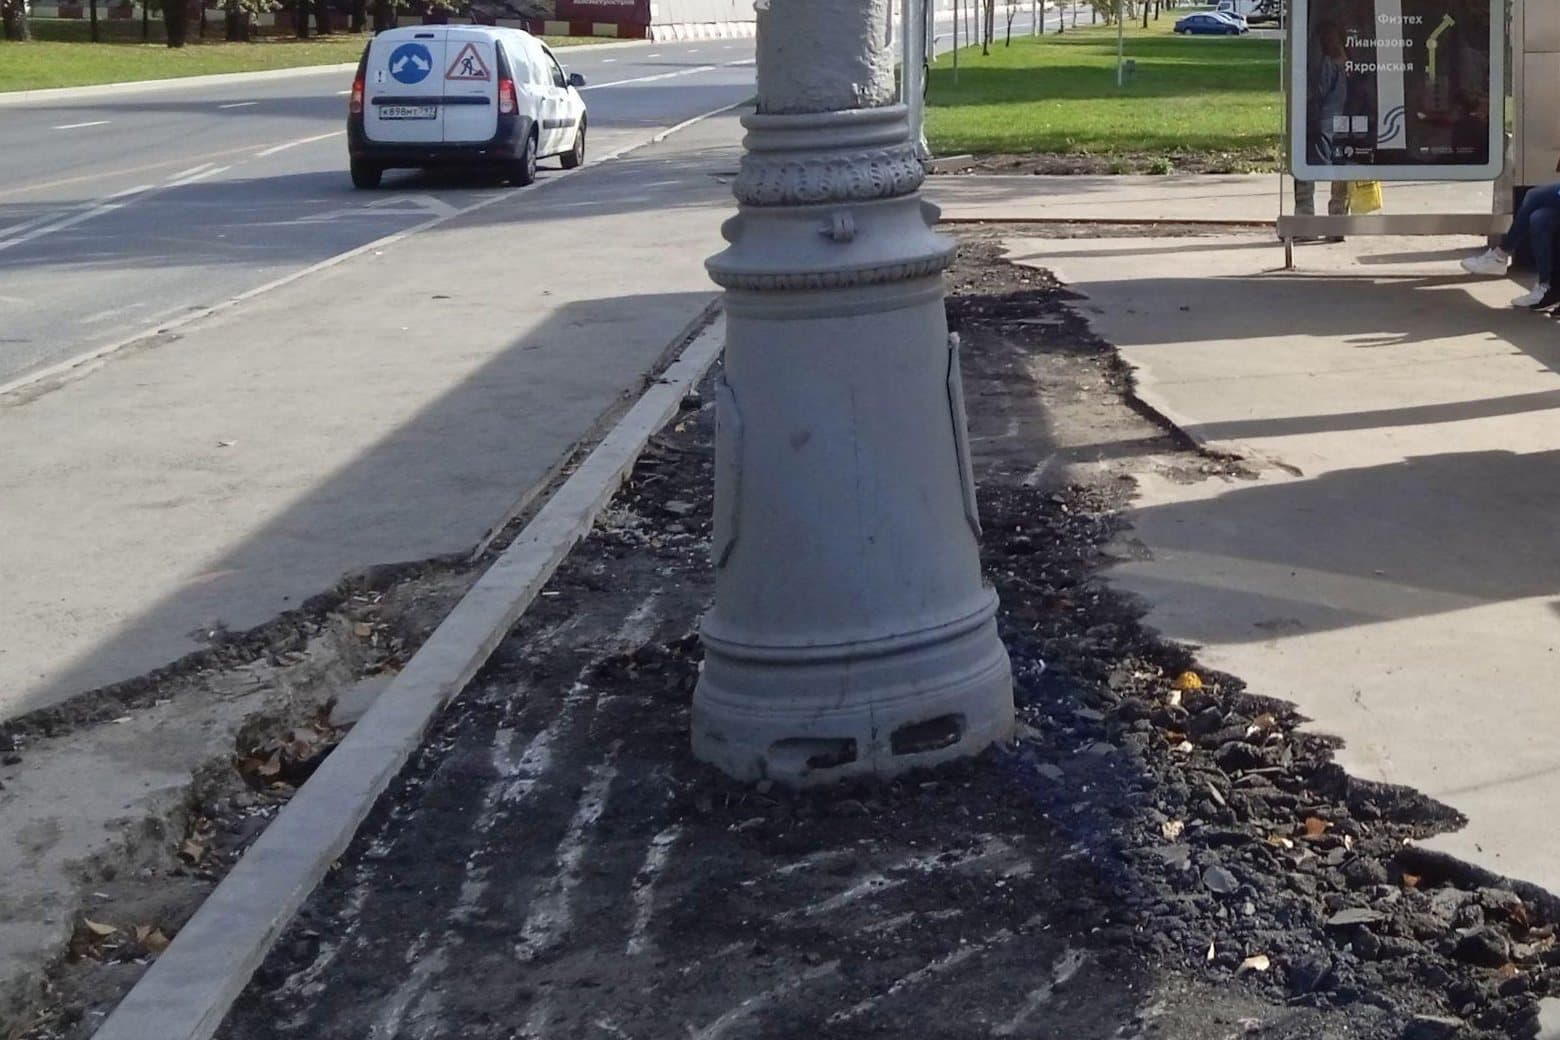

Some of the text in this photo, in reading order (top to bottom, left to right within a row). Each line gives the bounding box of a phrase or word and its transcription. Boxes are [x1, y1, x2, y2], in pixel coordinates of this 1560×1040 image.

[1377, 13, 1423, 25] Физтех
[1345, 35, 1414, 48] Лианозово
[1345, 61, 1414, 74] Яхромская
